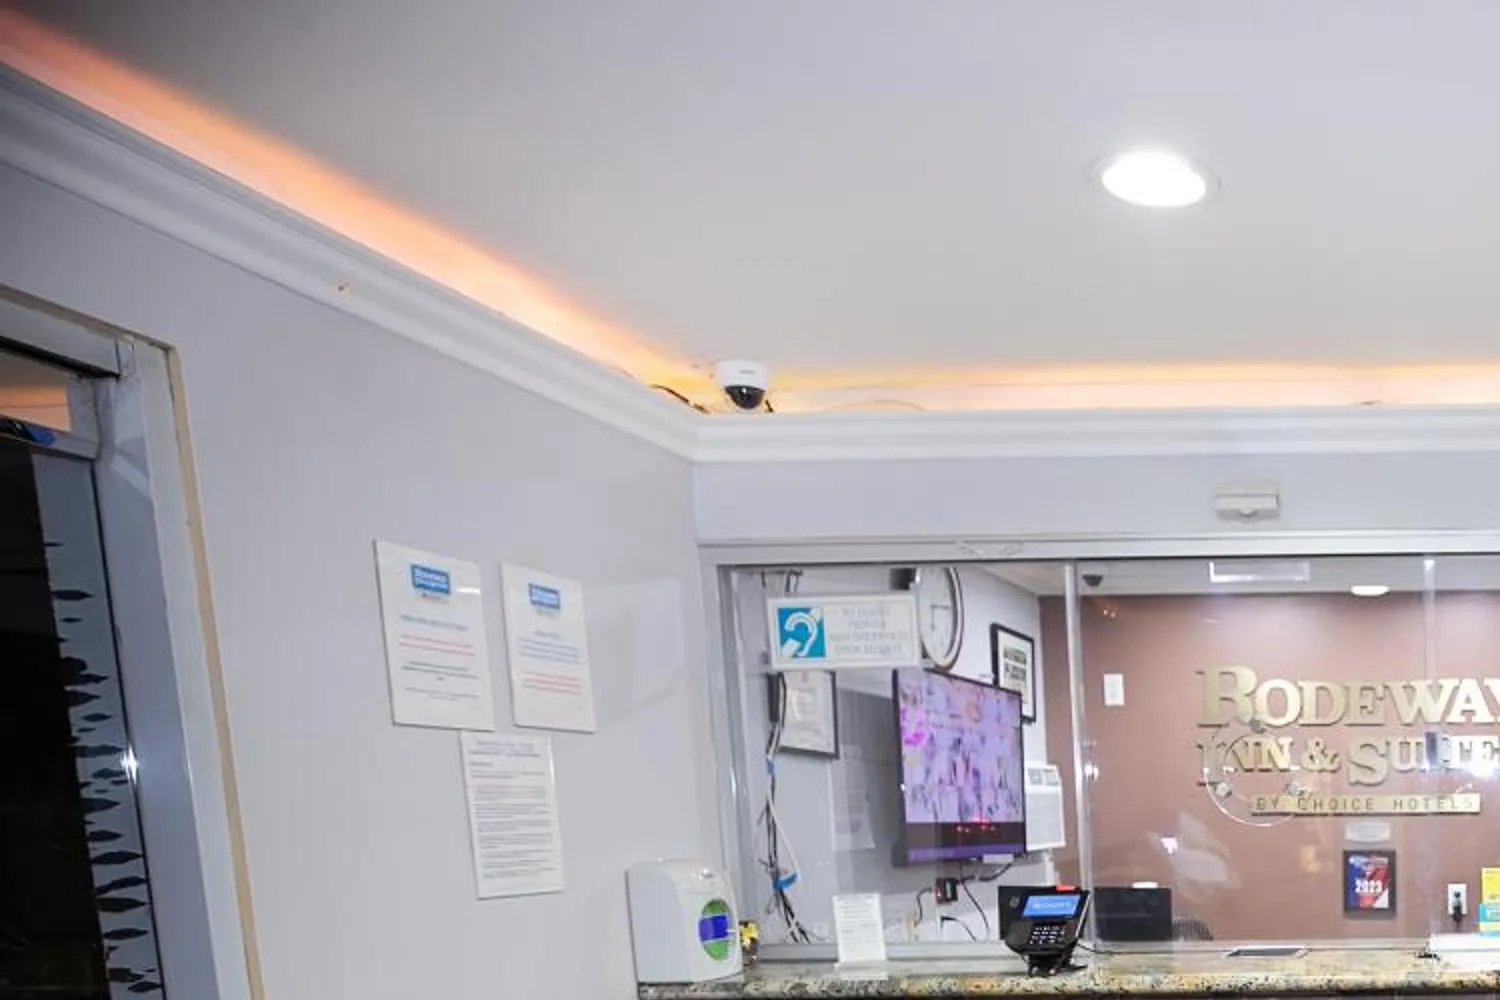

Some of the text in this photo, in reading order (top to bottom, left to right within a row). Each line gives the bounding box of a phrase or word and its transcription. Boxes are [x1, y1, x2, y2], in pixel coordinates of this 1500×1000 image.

[1196, 736, 1294, 786] INN
[1301, 734, 1342, 773] &
[1255, 796, 1475, 811] BY CHOICE HOTELS
